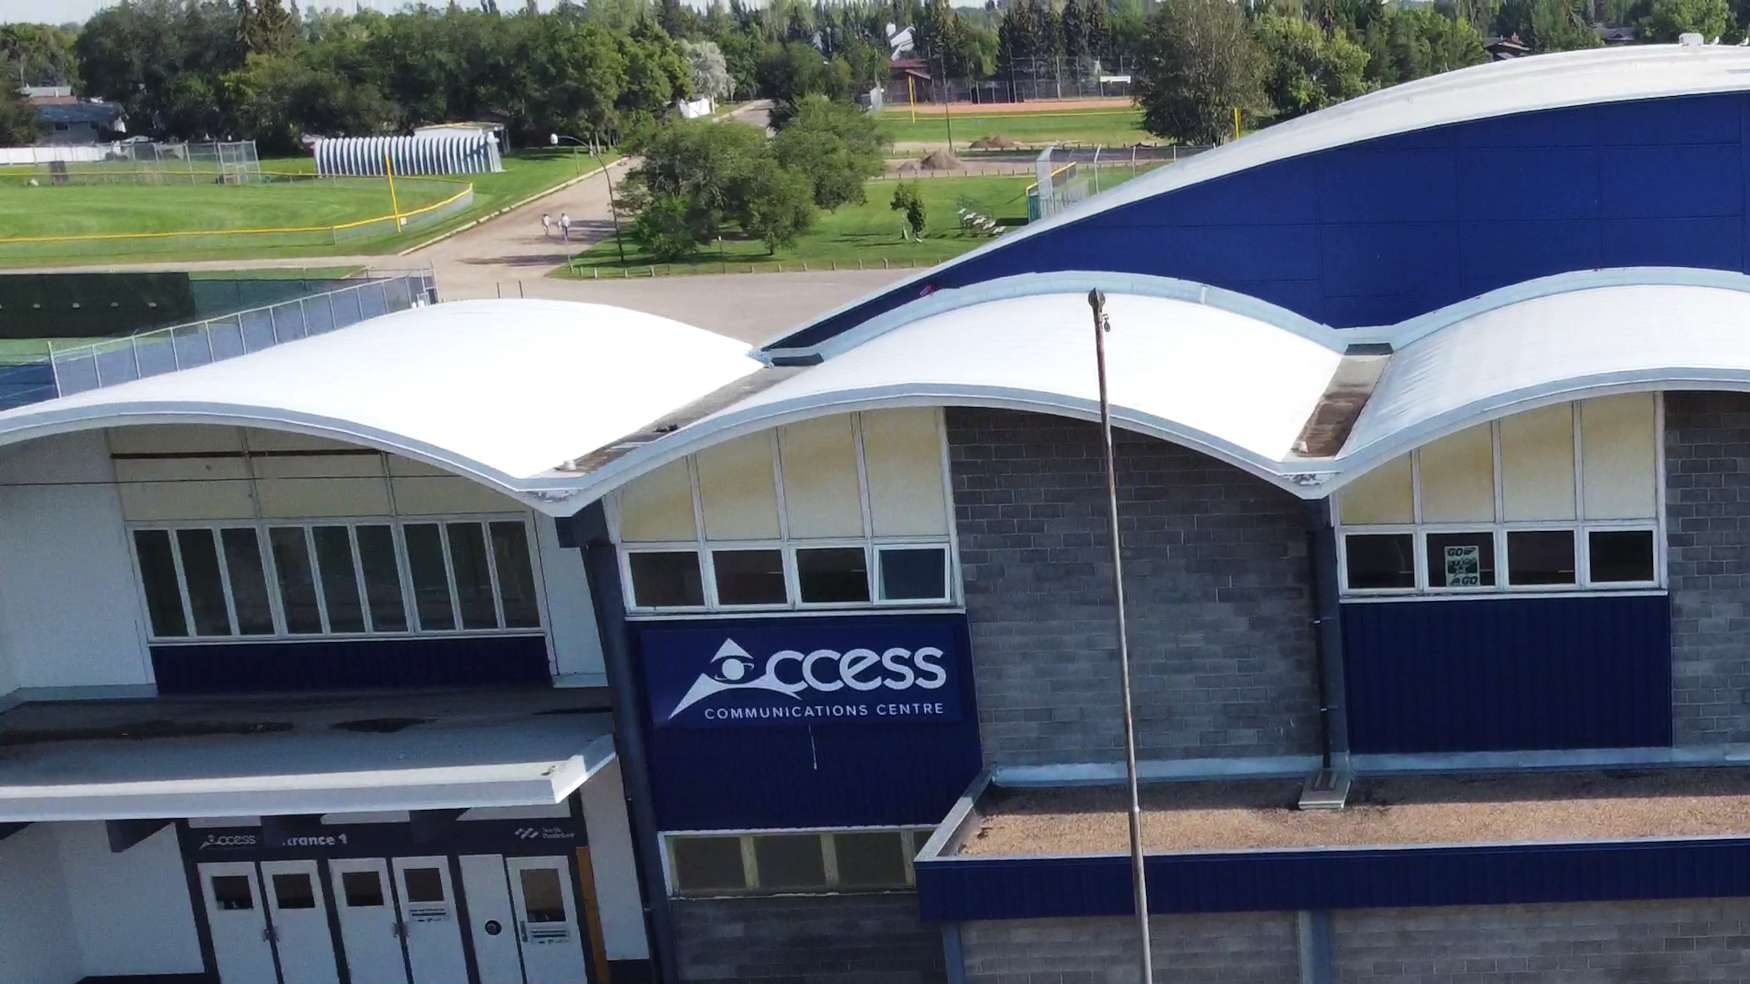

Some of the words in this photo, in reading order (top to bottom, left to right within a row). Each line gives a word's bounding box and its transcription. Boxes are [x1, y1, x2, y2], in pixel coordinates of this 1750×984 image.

[1447, 547, 1463, 556] GO
[704, 703, 868, 720] COMMUNICATIONS
[877, 702, 945, 716] CENTRE
